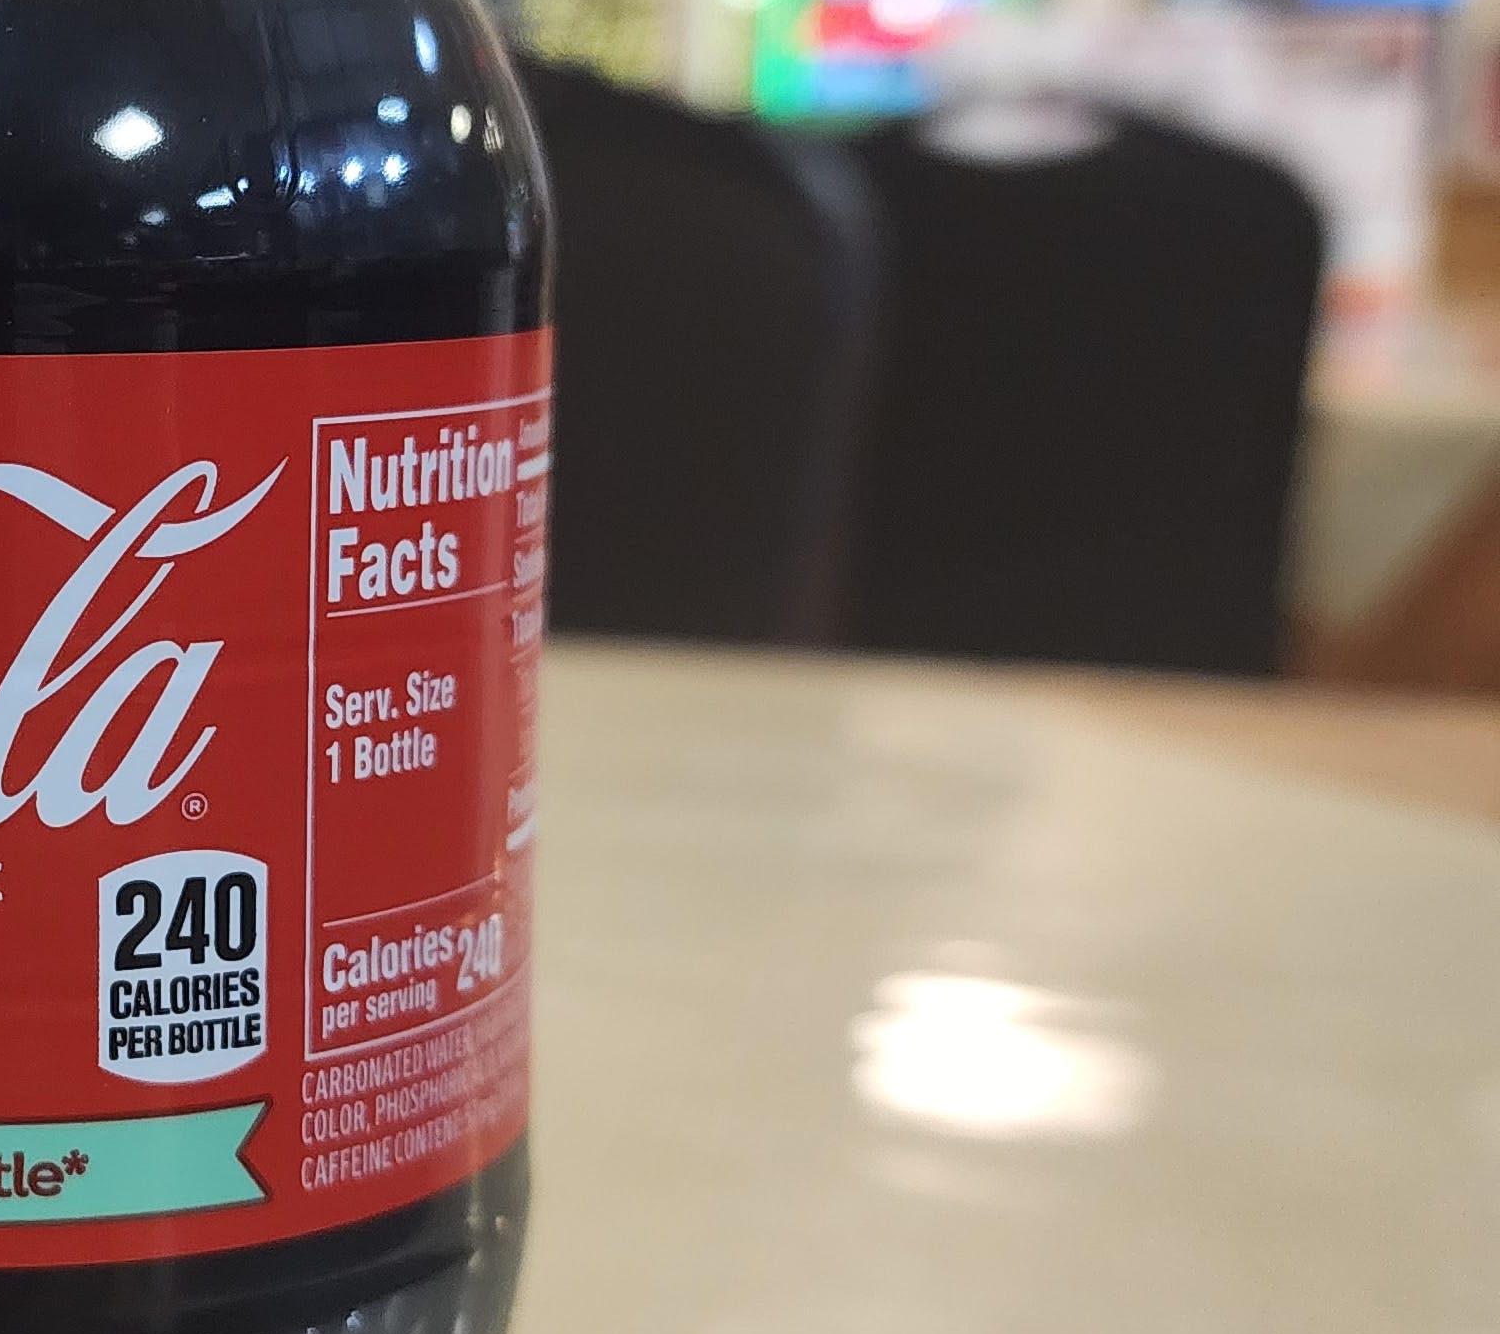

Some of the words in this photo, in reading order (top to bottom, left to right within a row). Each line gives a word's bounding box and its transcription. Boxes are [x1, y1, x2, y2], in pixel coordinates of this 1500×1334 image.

[328, 424, 514, 515] Nutrition
[326, 520, 461, 604] Facts
[325, 683, 399, 730] Serv.
[405, 669, 456, 718] Size
[325, 740, 341, 784] 1
[353, 725, 436, 780] Bottle
[114, 871, 258, 972] 240
[322, 924, 454, 993] Calories
[456, 912, 504, 991] 240
[108, 967, 261, 1020] CALORIES
[321, 998, 360, 1040] per
[364, 977, 437, 1023] serving
[108, 1024, 163, 1061] PER
[167, 1012, 262, 1056] BOTTLE
[301, 1041, 423, 1105] CARBONATED
[301, 1099, 371, 1145] COLOR,
[301, 1135, 392, 1191] CAFFEINE
